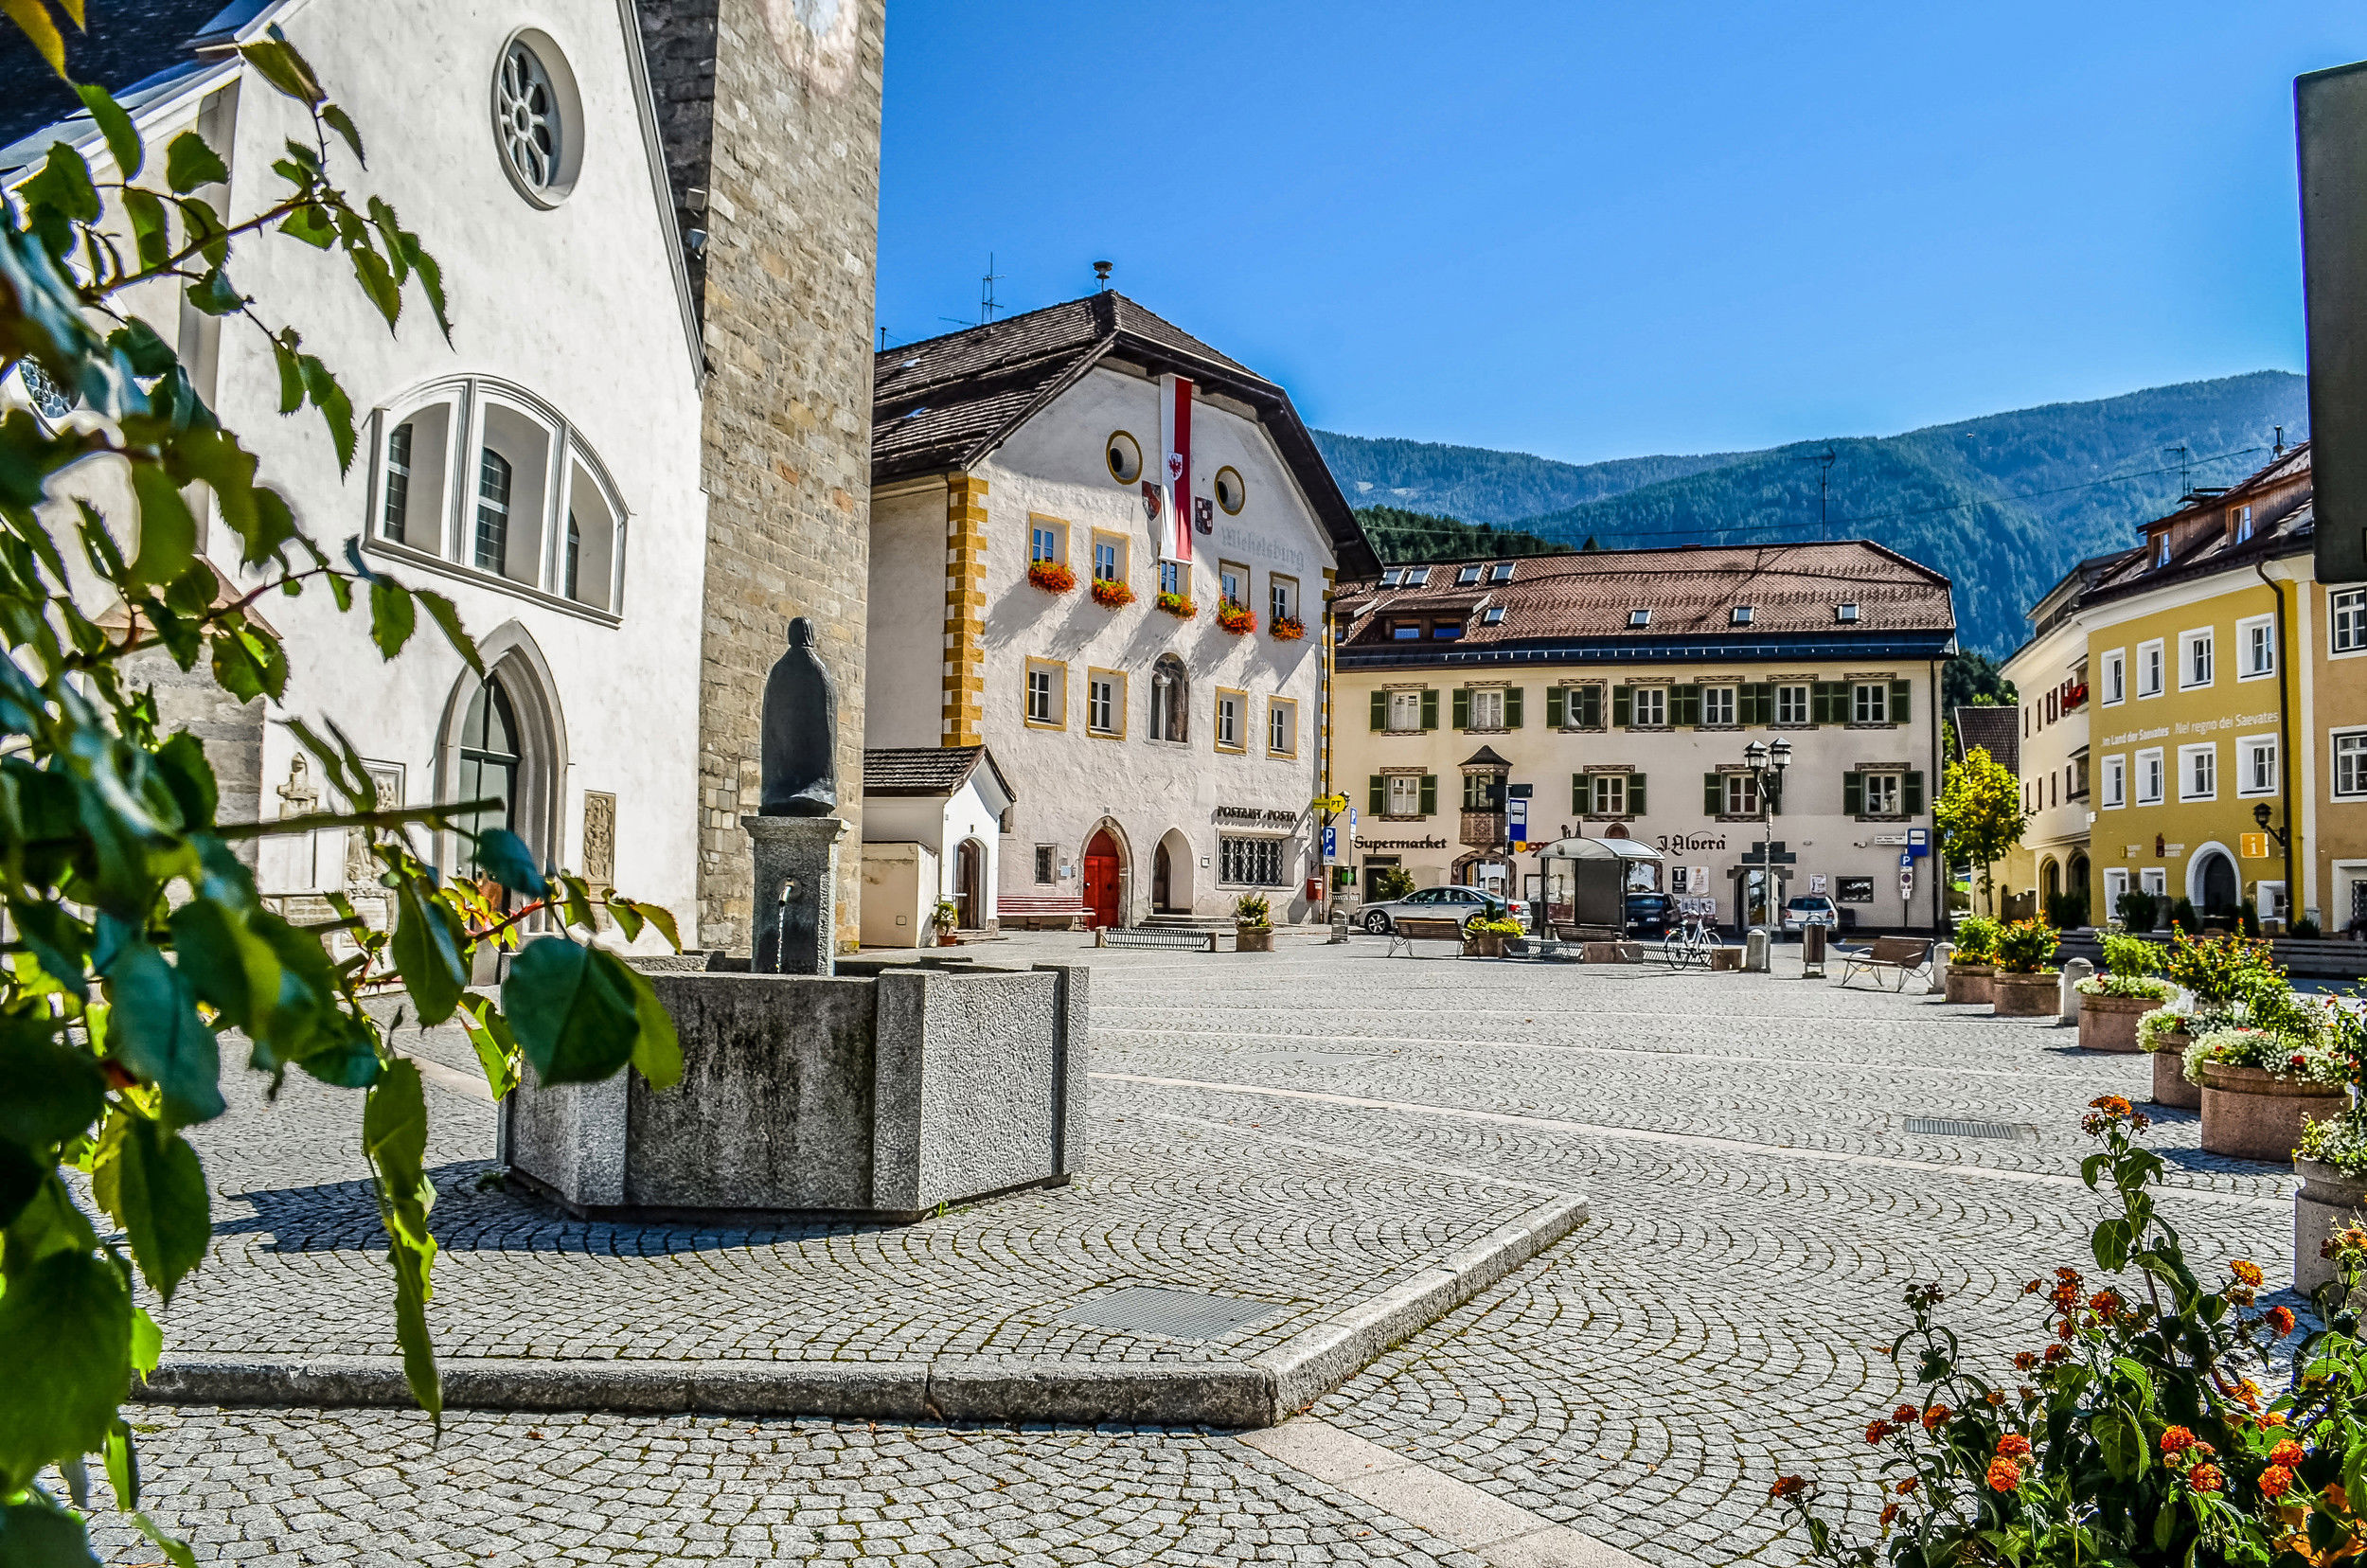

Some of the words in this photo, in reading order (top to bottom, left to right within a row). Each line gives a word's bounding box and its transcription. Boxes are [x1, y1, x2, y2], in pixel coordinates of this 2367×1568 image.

[2175, 722, 2190, 735] Nel
[2192, 720, 2217, 735] regno
[2219, 716, 2234, 729] dei
[2235, 712, 2279, 727] Saevates
[2111, 732, 2127, 745] Land
[2139, 726, 2169, 741] Saevates
[1217, 805, 1262, 820] POSTAMT
[1268, 809, 1298, 822] POSTA
[1326, 829, 1334, 844] P
[1354, 834, 1447, 854] Supermarket
[1902, 856, 1911, 865] P
[1673, 868, 1685, 881] T
